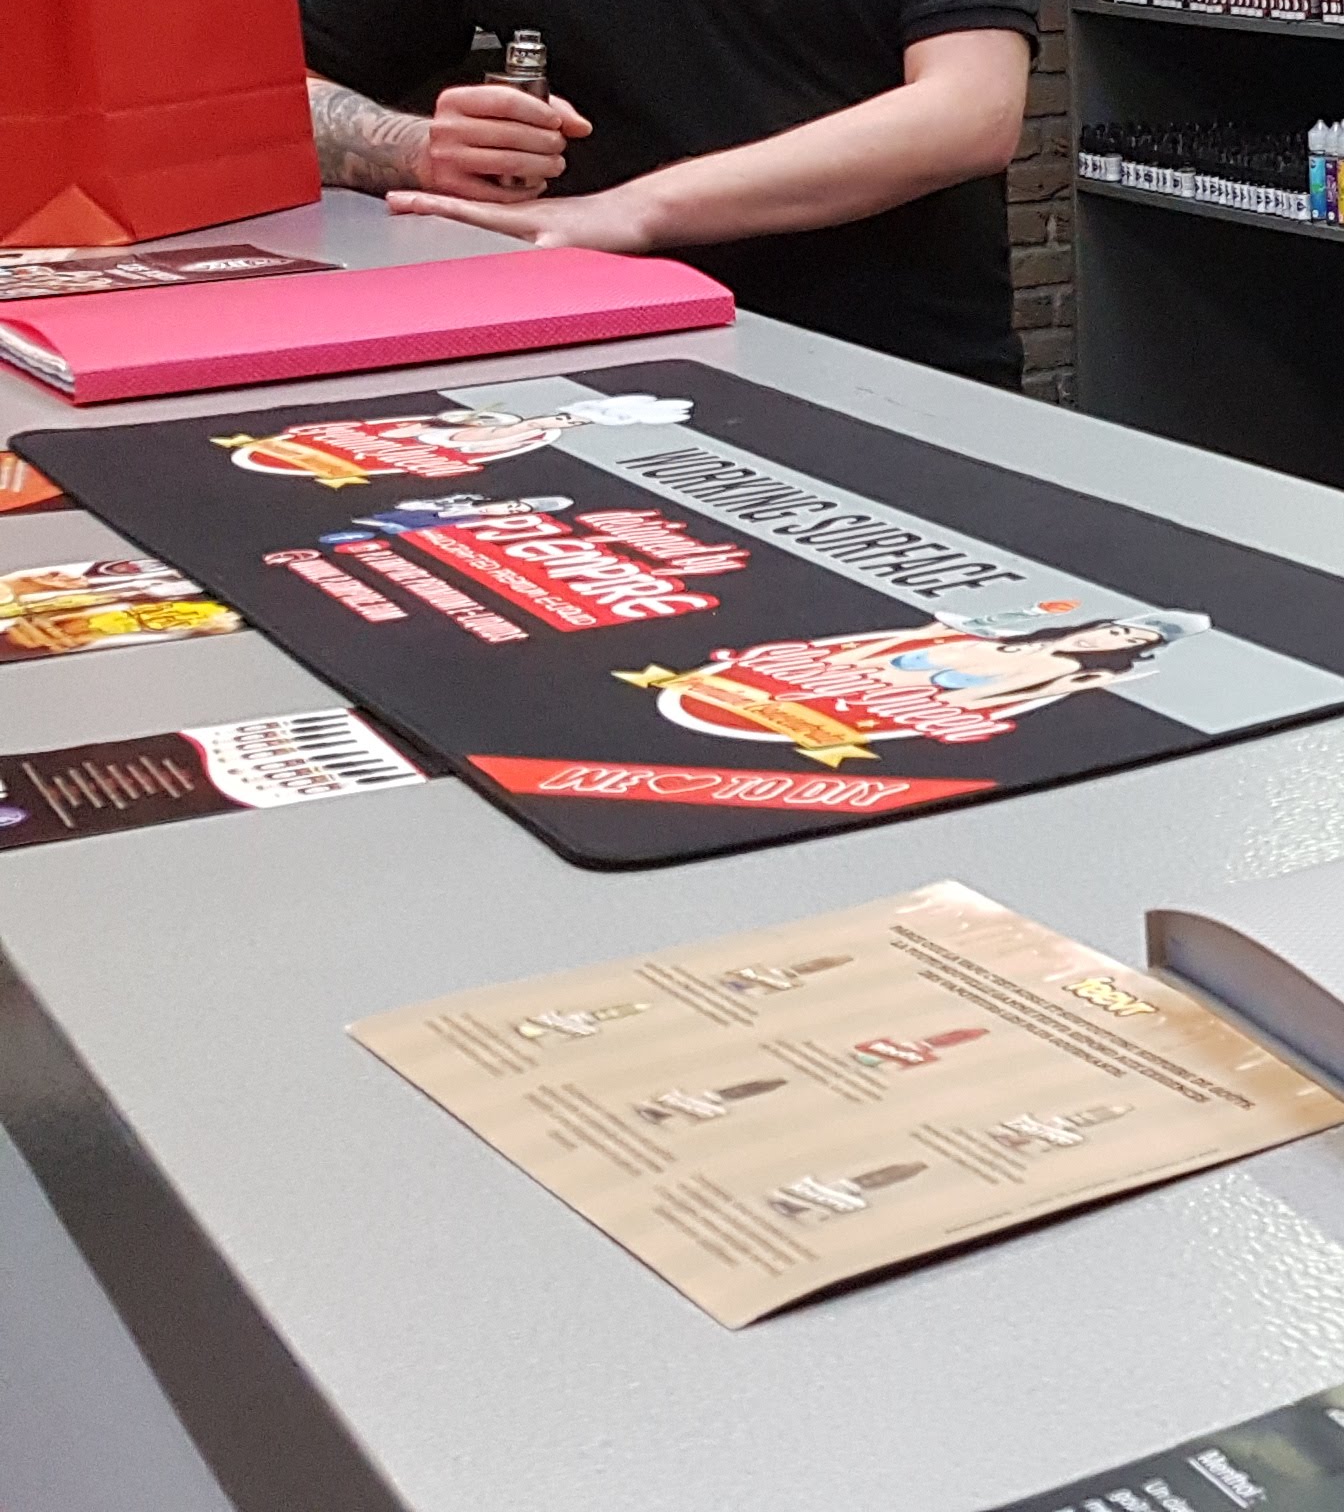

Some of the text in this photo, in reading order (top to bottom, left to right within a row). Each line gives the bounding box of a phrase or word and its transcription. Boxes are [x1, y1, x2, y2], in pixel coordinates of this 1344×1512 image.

[577, 509, 750, 576] designed by
[616, 447, 1026, 598] WORKING SURFACE
[455, 514, 708, 619] PJ EMPIRE
[711, 642, 893, 700] Slushy
[835, 684, 1016, 743] Queen
[539, 765, 910, 807] WE TO DIY
[1196, 1447, 1262, 1502] Menthol
